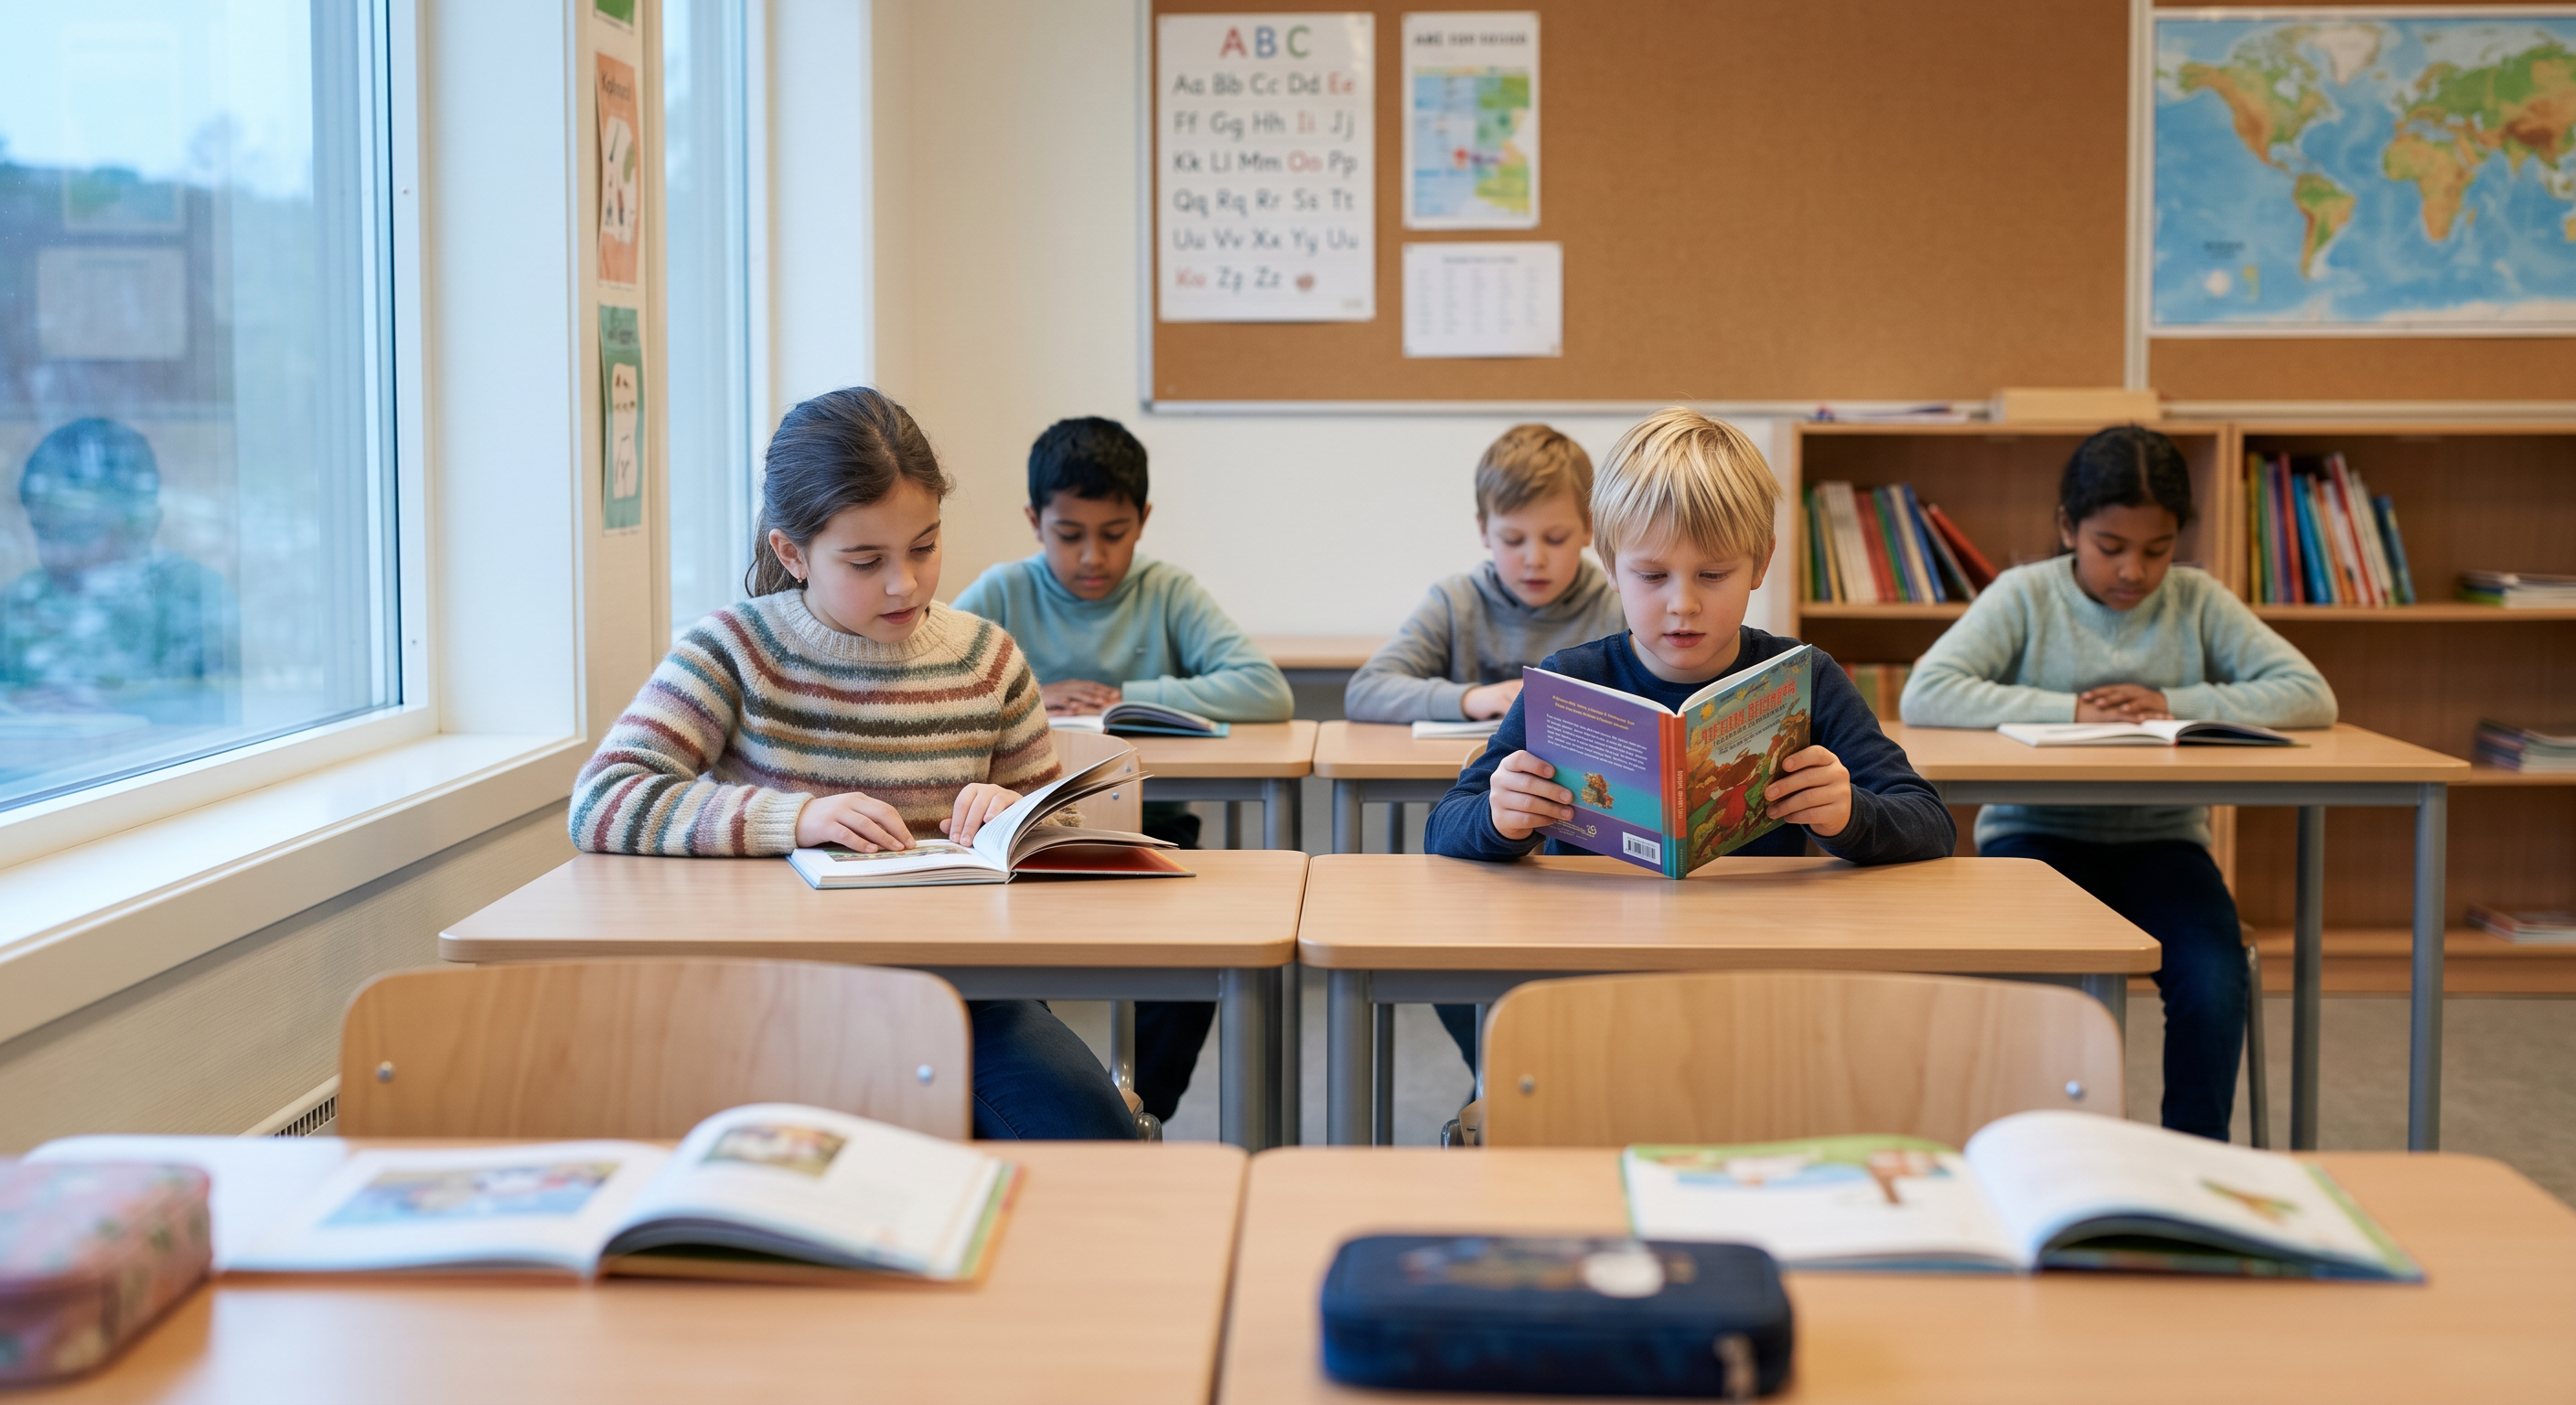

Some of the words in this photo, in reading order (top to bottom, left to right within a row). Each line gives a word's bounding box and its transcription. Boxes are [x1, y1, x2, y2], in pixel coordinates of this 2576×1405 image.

[1172, 73, 1205, 96] Aa
[1212, 72, 1244, 96] Bb
[1248, 71, 1281, 96] Cc
[1287, 71, 1321, 96] Dd
[1327, 71, 1356, 96] Ee
[1174, 110, 1198, 134] Ff
[1208, 110, 1245, 143] Gg
[1252, 111, 1285, 134] Hh
[1297, 110, 1315, 134] Ii
[1329, 109, 1355, 142] Jj
[1173, 151, 1201, 172] Kk
[1238, 151, 1282, 171] Mm
[1286, 149, 1324, 174] Oo
[1327, 149, 1358, 180] Pp
[1172, 188, 1209, 219] Qq
[1256, 188, 1281, 209] Rr
[1293, 188, 1319, 211] Ss
[1329, 187, 1354, 211] Tt
[1172, 228, 1207, 252] Uu
[1212, 228, 1244, 250] Vv
[1290, 229, 1318, 257] Yy
[1326, 228, 1359, 251] Uu
